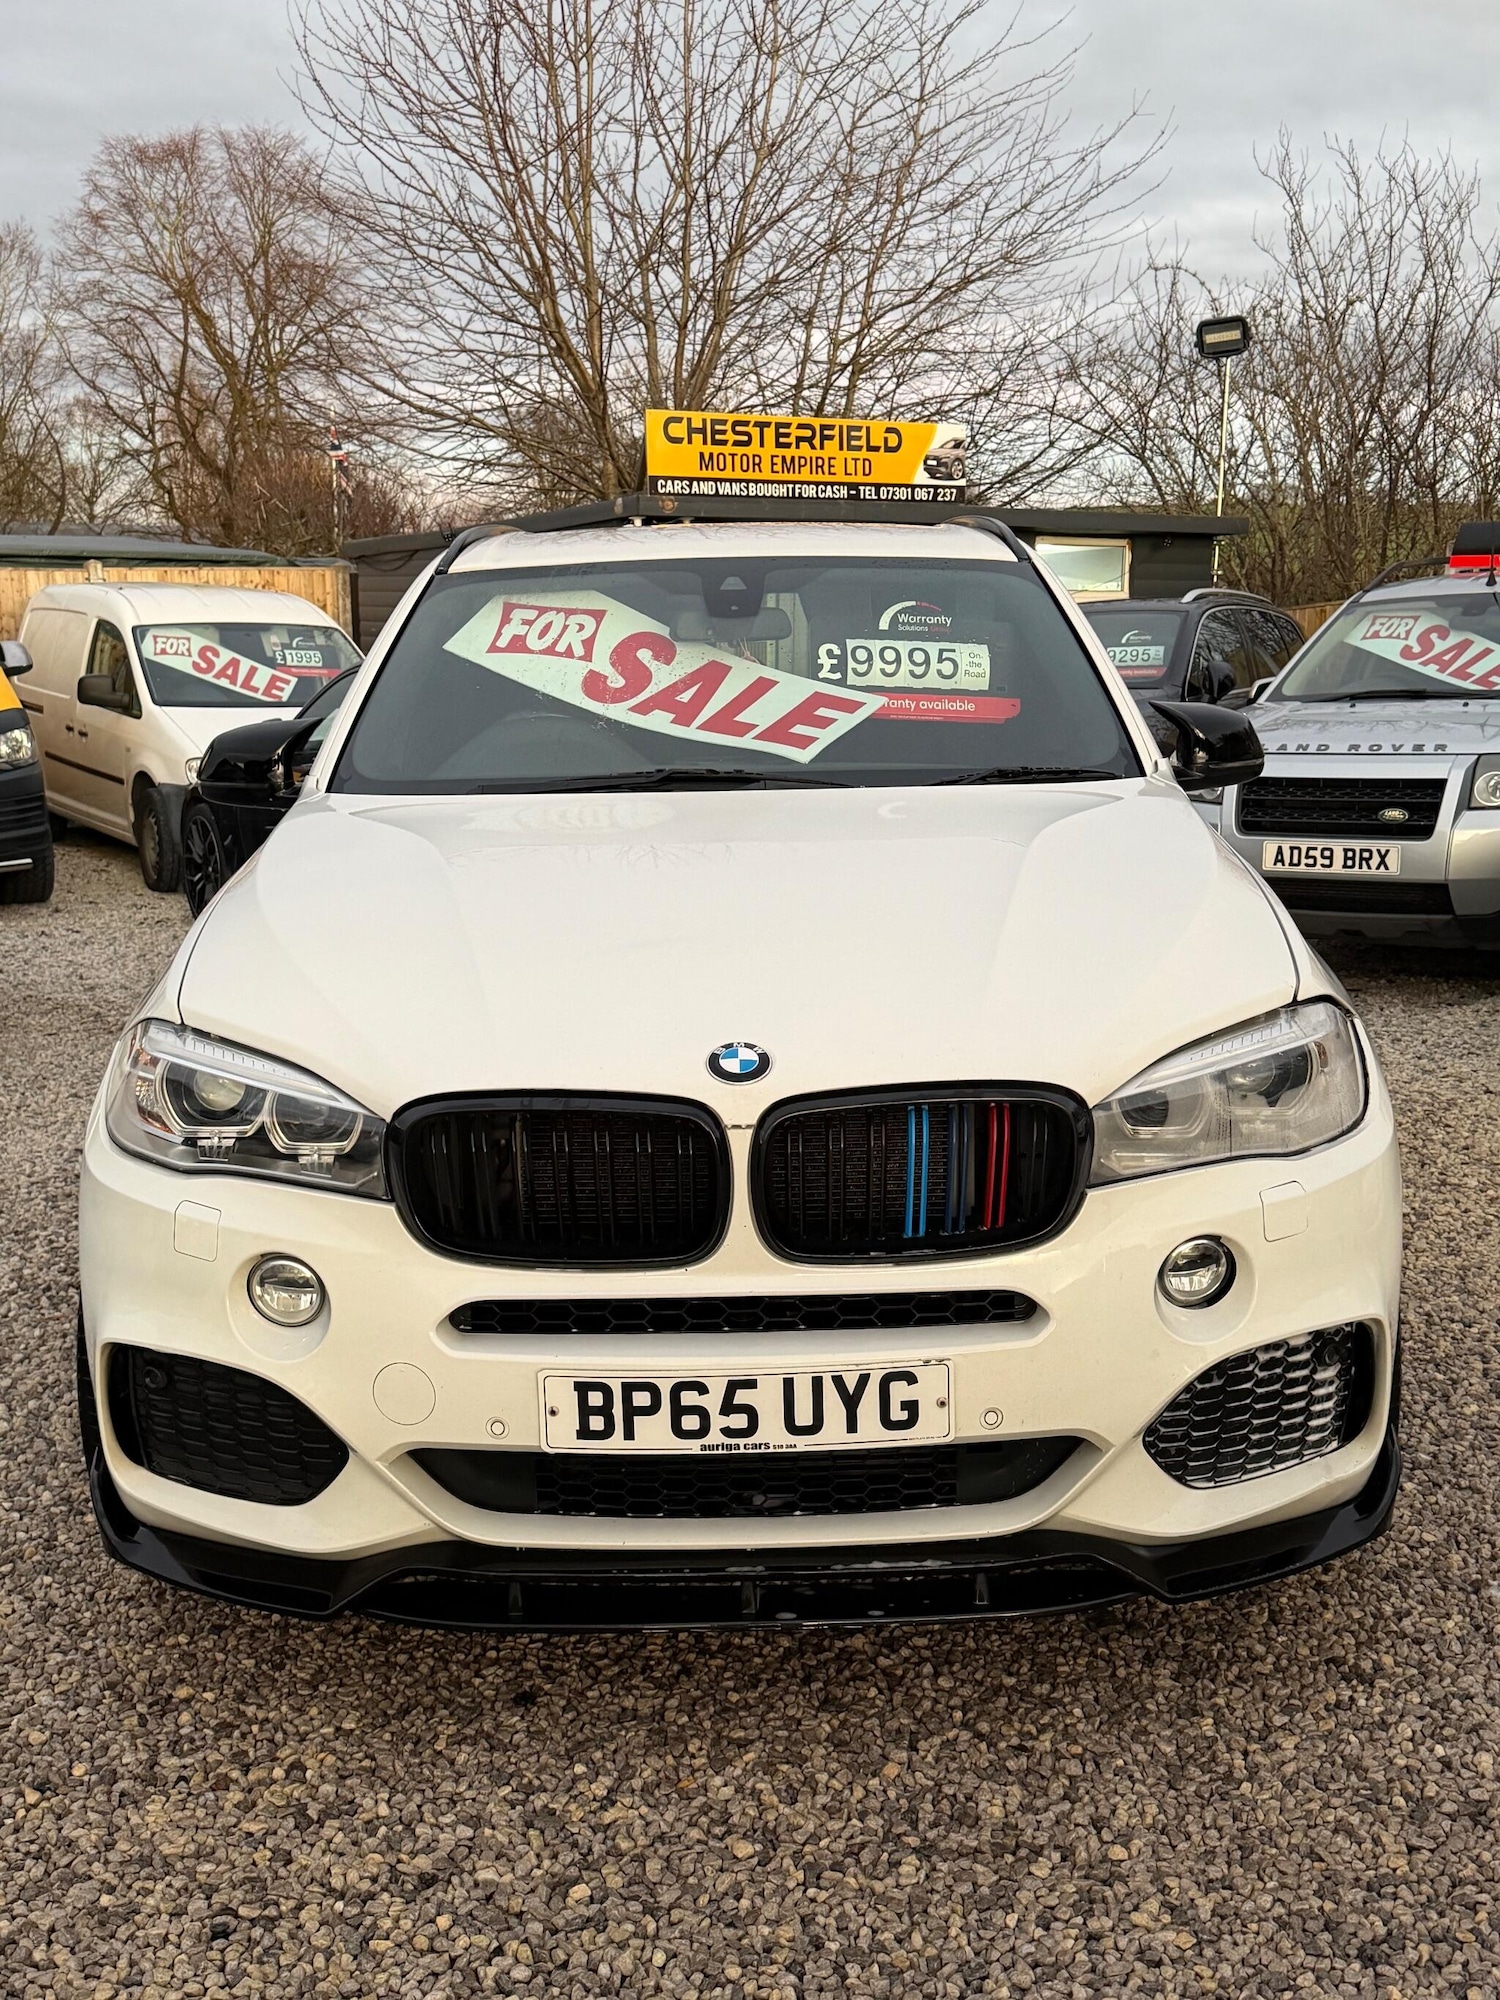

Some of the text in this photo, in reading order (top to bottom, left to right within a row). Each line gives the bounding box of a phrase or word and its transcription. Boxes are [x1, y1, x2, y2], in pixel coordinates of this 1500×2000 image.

[663, 416, 903, 453] CHESTERFIELD
[699, 451, 872, 477] MOTOR EMPIRE LTD
[657, 479, 690, 494] CARS
[690, 480, 716, 495] AND
[716, 481, 748, 497] VANS
[748, 482, 794, 498] BOUGHT
[794, 484, 817, 498] FOR
[817, 485, 848, 499] CASH
[858, 485, 878, 499] TEL
[879, 486, 912, 501] 07301
[914, 487, 934, 501] 067
[936, 488, 957, 502] 237
[897, 613, 953, 627] Warranty
[897, 624, 929, 632] Solutions
[1365, 617, 1416, 640] FOR
[968, 652, 981, 660] On
[1107, 648, 1151, 663] 9295
[156, 636, 292, 702] FOR SALE
[968, 660, 983, 669] the
[495, 607, 867, 750] FOR SALE
[963, 669, 987, 679] Road
[919, 698, 976, 712] available
[1347, 743, 1449, 752] ROVER
[1272, 845, 1391, 871] AD59 BRX
[713, 1042, 766, 1055] BMW
[573, 1370, 920, 1441] BP65 UYG
[700, 1442, 741, 1452] auriga
[743, 1442, 771, 1451] cars
